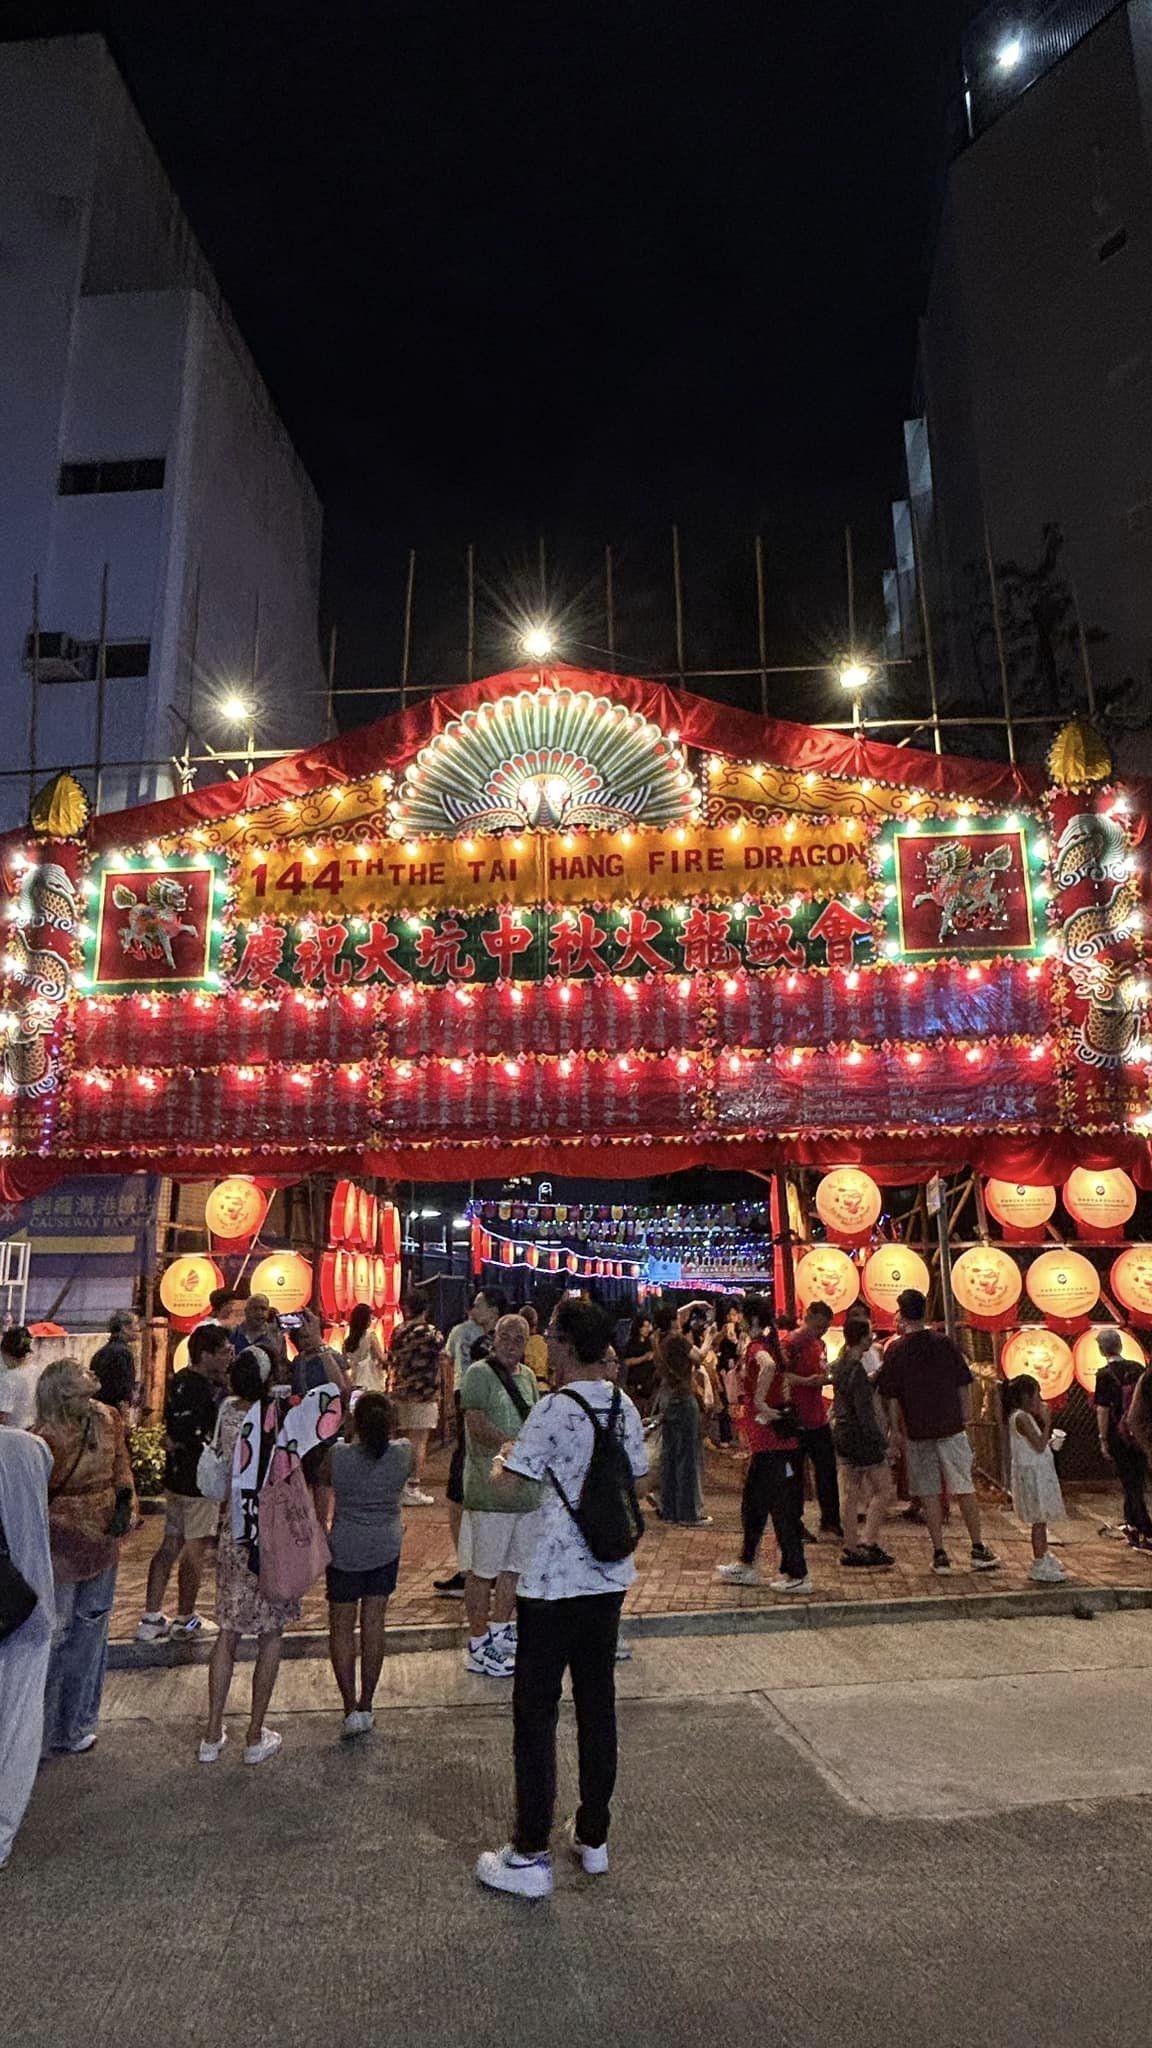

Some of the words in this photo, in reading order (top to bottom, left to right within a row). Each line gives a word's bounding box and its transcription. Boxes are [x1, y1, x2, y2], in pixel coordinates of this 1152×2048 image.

[388, 862, 446, 886] THE
[468, 859, 517, 883] TAI
[550, 854, 624, 881] HANG
[650, 847, 725, 875] FIRE
[744, 842, 867, 870] DRAGON
[234, 900, 873, 986] 慶祝大坑中秋火龍盛會
[30, 1217, 98, 1228] CAUSEWAY
